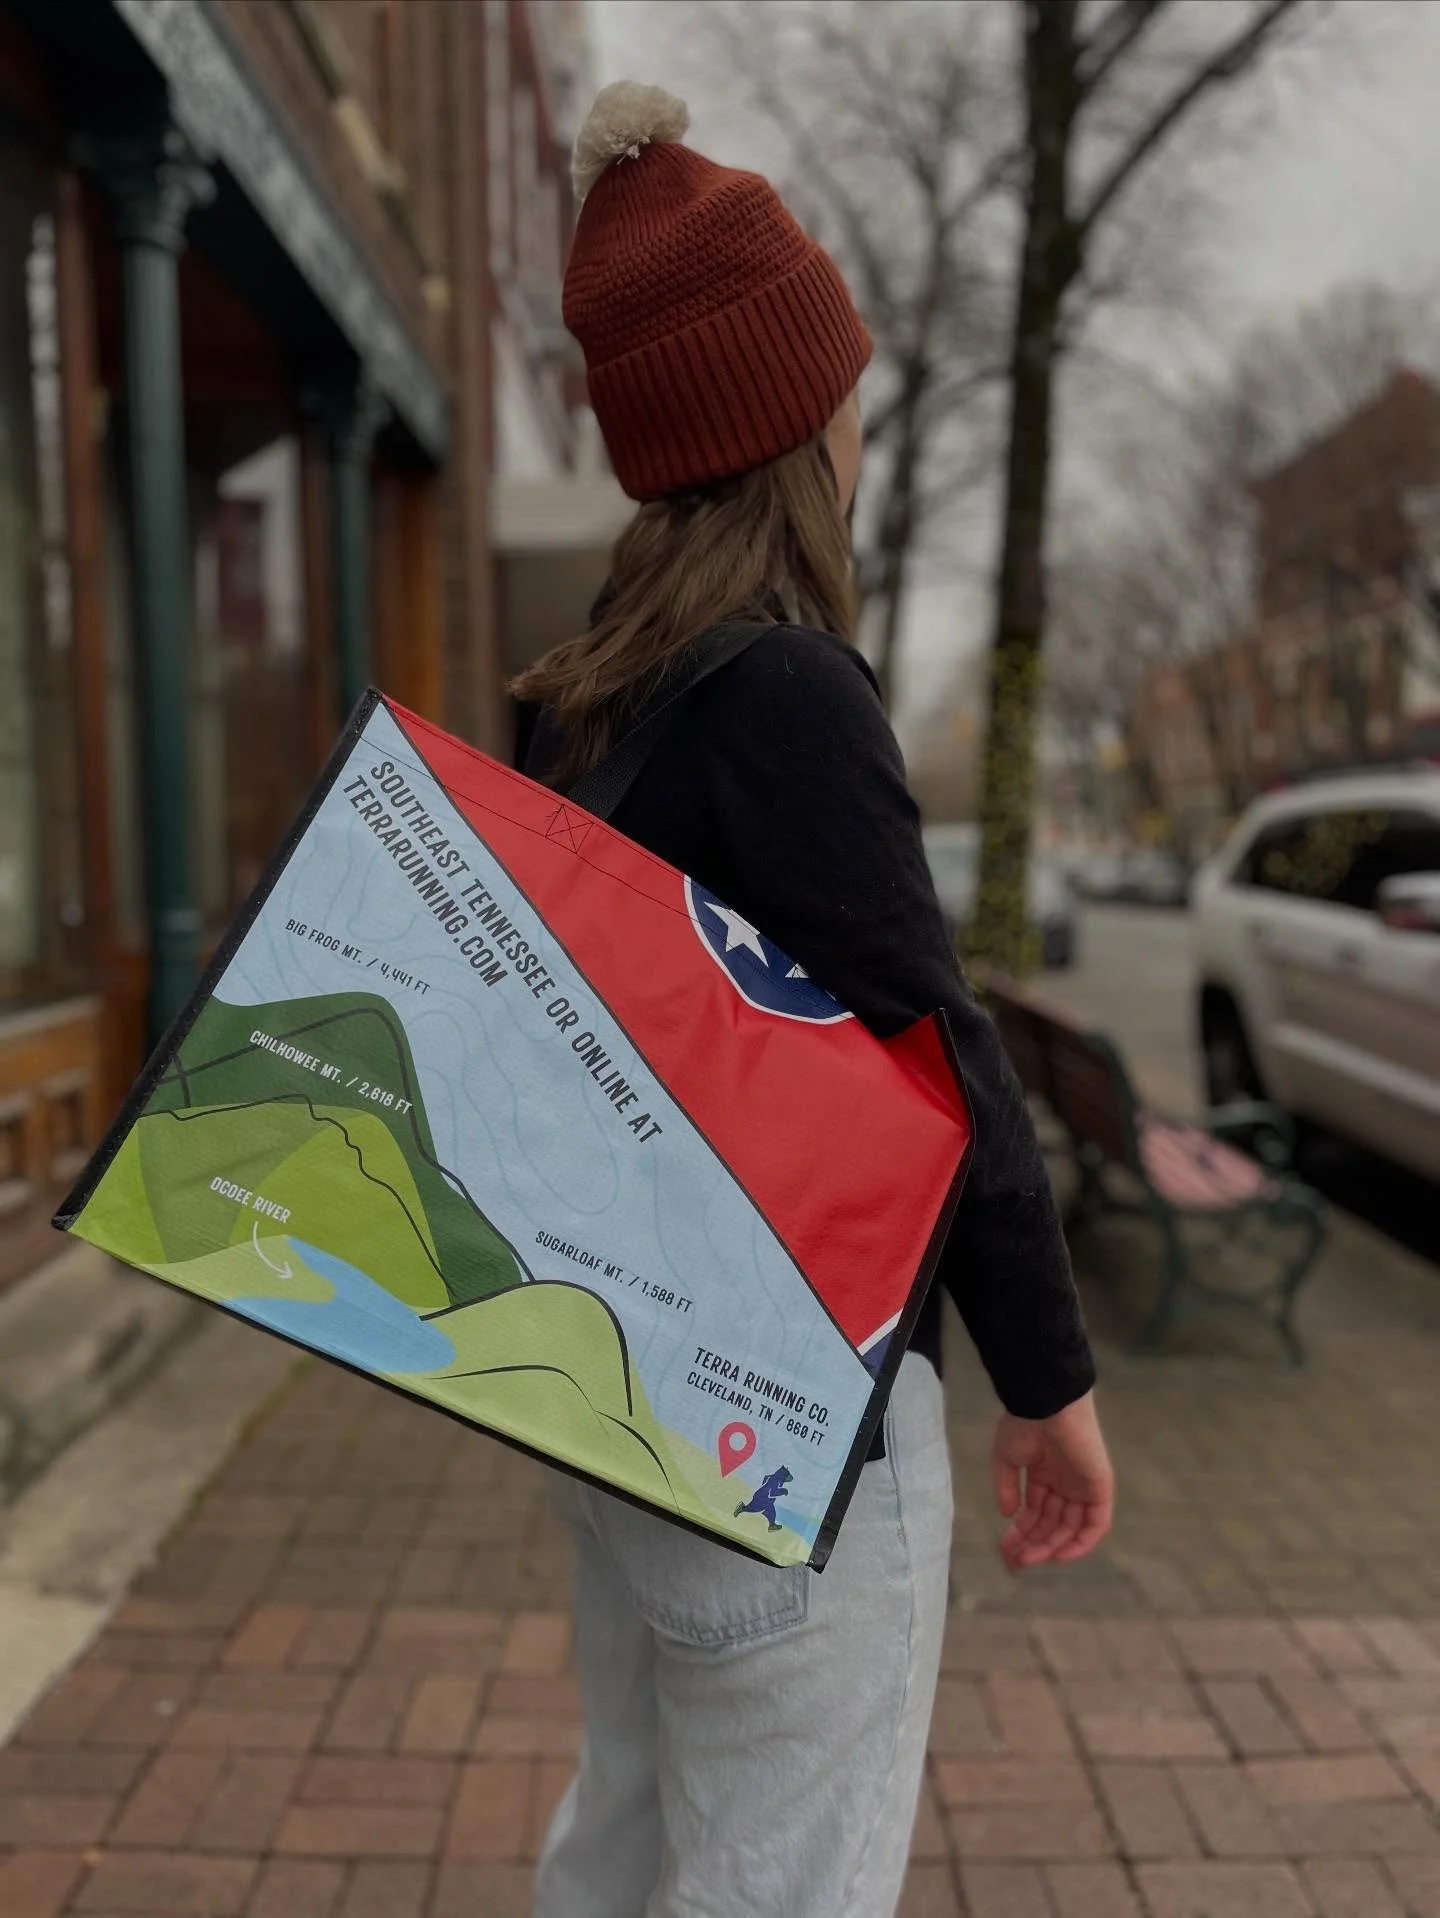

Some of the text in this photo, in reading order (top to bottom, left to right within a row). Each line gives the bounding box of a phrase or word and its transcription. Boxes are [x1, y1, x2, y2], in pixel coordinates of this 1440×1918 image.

[343, 775, 508, 988] TERRARUNNING.COM
[285, 918, 431, 996] BIG FROG MT. / 4,441 FT
[370, 761, 663, 1144] SOUTHEAST TENNESSEE OR ONLINE AT
[249, 1030, 413, 1116] CHILHOWEE MT. / 2,618 FT
[209, 1176, 292, 1224] OCOEE RIVER
[535, 1230, 693, 1314] SUGARLOAF MT. / 1,588 FT
[686, 1371, 754, 1415] CLEVELAND,
[758, 1404, 774, 1421] TN
[774, 1414, 785, 1425] /
[810, 1430, 825, 1446] FT
[694, 1347, 829, 1427] TERRA RUNNING CO.
